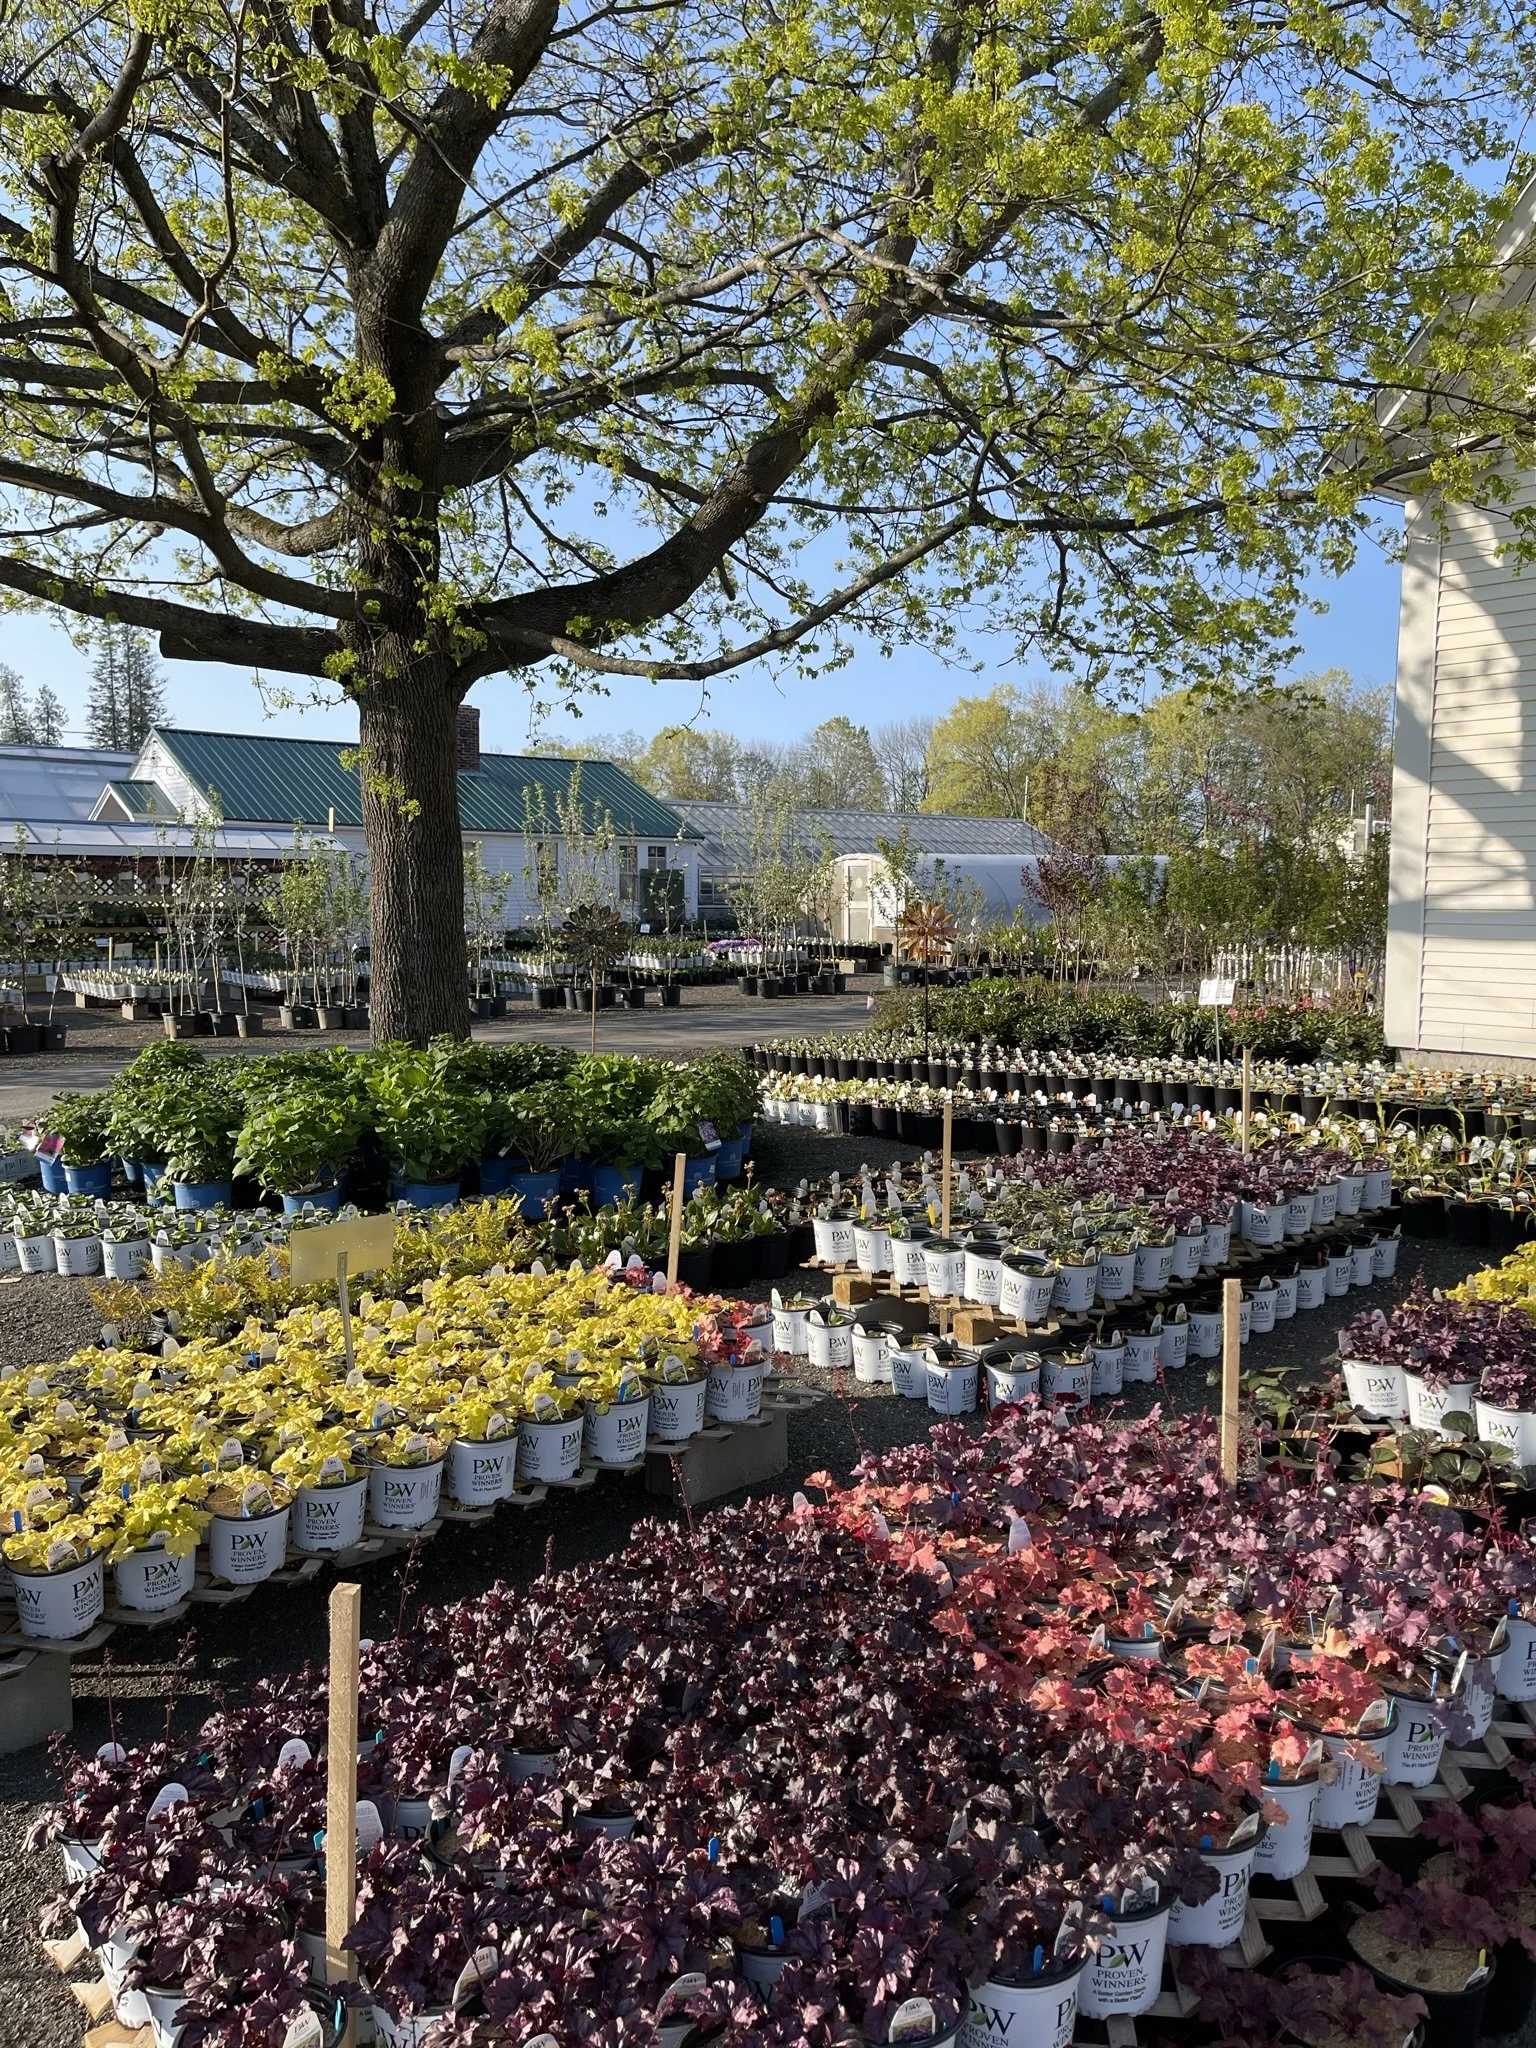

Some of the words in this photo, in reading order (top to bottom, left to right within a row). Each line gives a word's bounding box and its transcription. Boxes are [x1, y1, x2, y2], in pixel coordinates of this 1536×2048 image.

[1290, 1205, 1309, 1214] PW
[1250, 1214, 1271, 1225] PW
[832, 1230, 851, 1241] PW
[23, 1246, 40, 1256] PW
[906, 1252, 925, 1263] PW
[977, 1268, 999, 1281] PW
[1101, 1266, 1123, 1277] PW
[1004, 1280, 1021, 1294] PW
[1251, 1300, 1271, 1311] PW
[829, 1336, 849, 1348] PW
[893, 1362, 911, 1374] PW
[928, 1375, 945, 1389] PW
[1367, 1377, 1395, 1392] PW
[652, 1395, 679, 1411] PW
[1418, 1393, 1447, 1410] PW
[617, 1414, 643, 1433] PW
[1488, 1421, 1518, 1439] PW
[472, 1456, 503, 1474] PW
[384, 1480, 416, 1497] PW
[471, 1478, 502, 1487] WINNERS
[306, 1501, 340, 1518] PW
[383, 1502, 415, 1510] WINNERS
[305, 1523, 339, 1531] WINNERS
[231, 1531, 268, 1550] PW
[230, 1553, 267, 1563] WINNERS
[233, 1548, 264, 1557] PROVEN
[143, 1557, 182, 1582] PW
[143, 1578, 182, 1593] WINNERS
[146, 1573, 179, 1587] PROVEN
[1407, 1742, 1439, 1752] PROVEN
[1094, 1939, 1150, 1968] PW
[1097, 1967, 1143, 1979] PROVEN
